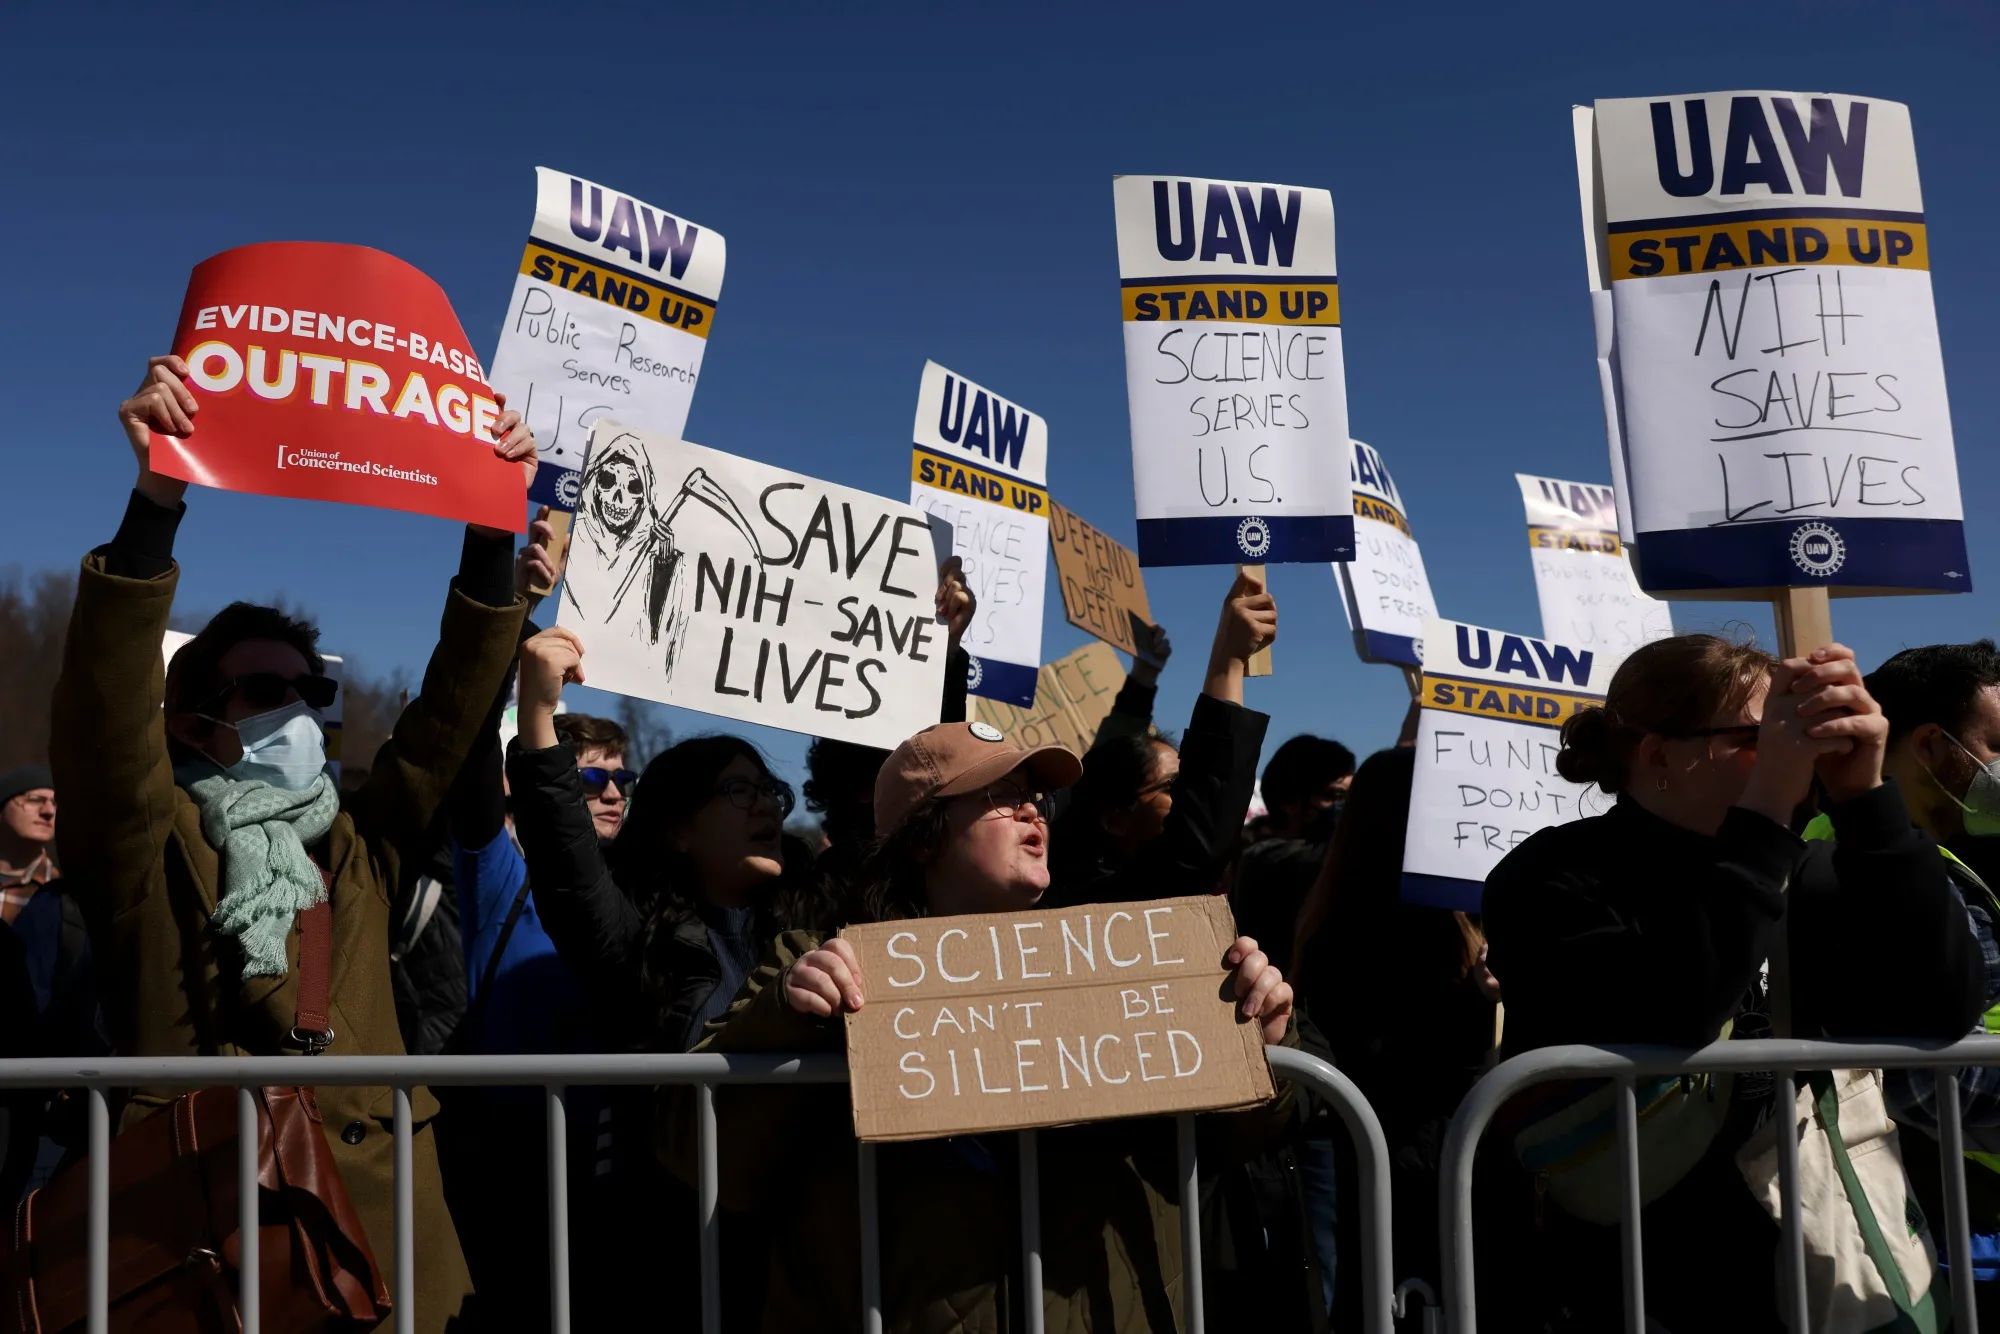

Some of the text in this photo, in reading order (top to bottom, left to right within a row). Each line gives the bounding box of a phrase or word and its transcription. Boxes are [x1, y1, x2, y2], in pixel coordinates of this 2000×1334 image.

[1649, 96, 1869, 199] UAW
[570, 178, 698, 280] UAW
[1152, 180, 1302, 268] UAW
[1627, 227, 1914, 278] STAND UP
[531, 254, 704, 329] STAND UP
[1134, 289, 1328, 322] STAND UP
[1694, 268, 1863, 360] NIH
[516, 287, 697, 384] Public Research
[1155, 328, 1327, 384] SCIENCE
[184, 341, 501, 447] OUTRAGE
[562, 359, 631, 395] Serves
[1710, 369, 1902, 429] SAVES
[938, 374, 1030, 470] UAW
[1189, 394, 1309, 436] SERVES
[287, 453, 438, 485] Concerned Scientists
[300, 448, 339, 460] Union of
[1198, 444, 1282, 507] U.S.
[919, 458, 1043, 514] STAND UP
[1353, 499, 1395, 525] TAND
[1718, 452, 1926, 521] LIVES
[759, 482, 932, 599] SAVE
[1050, 500, 1134, 588] DEFEND
[1246, 531, 1262, 541] UAW
[1538, 533, 1615, 553] STAND
[1805, 543, 1829, 556] UAW
[694, 552, 794, 626] NIH
[831, 596, 935, 662] SAVE
[1066, 576, 1133, 646] DEFUN
[714, 626, 887, 719] LIVES
[1456, 625, 1594, 688] UAW
[1433, 683, 1561, 719] STAND
[1458, 780, 1566, 815] DON'T
[886, 906, 1185, 988] SCIENCE
[894, 984, 1175, 1040] CAN'T BE
[898, 1029, 1203, 1099] SILENCED
